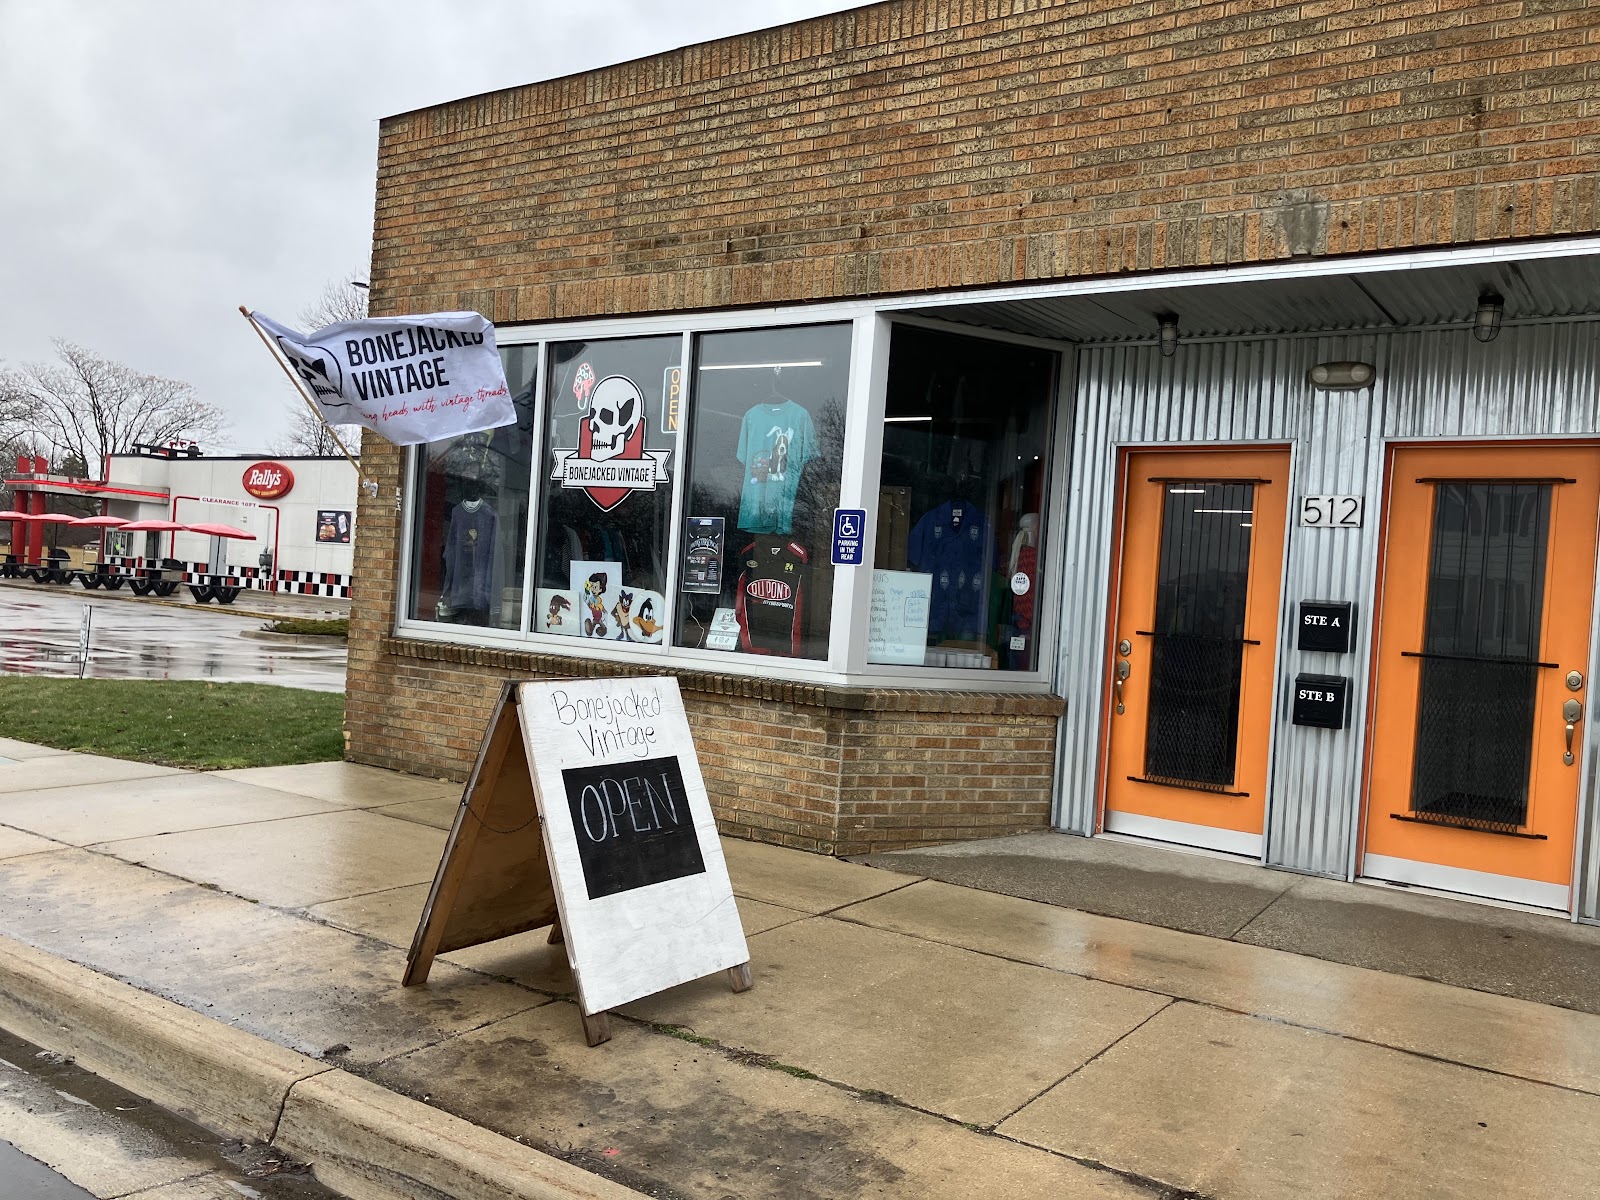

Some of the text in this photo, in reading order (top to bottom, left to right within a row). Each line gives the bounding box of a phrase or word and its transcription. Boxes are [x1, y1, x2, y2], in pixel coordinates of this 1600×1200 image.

[351, 357, 449, 400] VINTAGE
[382, 401, 408, 422] heads
[412, 395, 437, 413] with
[440, 393, 474, 413] vintage
[668, 369, 680, 431] OPEN
[249, 469, 282, 489] Rally's
[569, 466, 650, 482] BONEJACKED VINTAGE
[202, 497, 240, 506] CLEARANCE
[1304, 498, 1359, 524] 512
[784, 562, 794, 572] 24
[1304, 615, 1341, 627] STE A
[550, 687, 662, 725] Bonejacked
[1299, 690, 1335, 702] STE B
[577, 717, 657, 758] Vintage
[580, 773, 678, 842] OPEN
